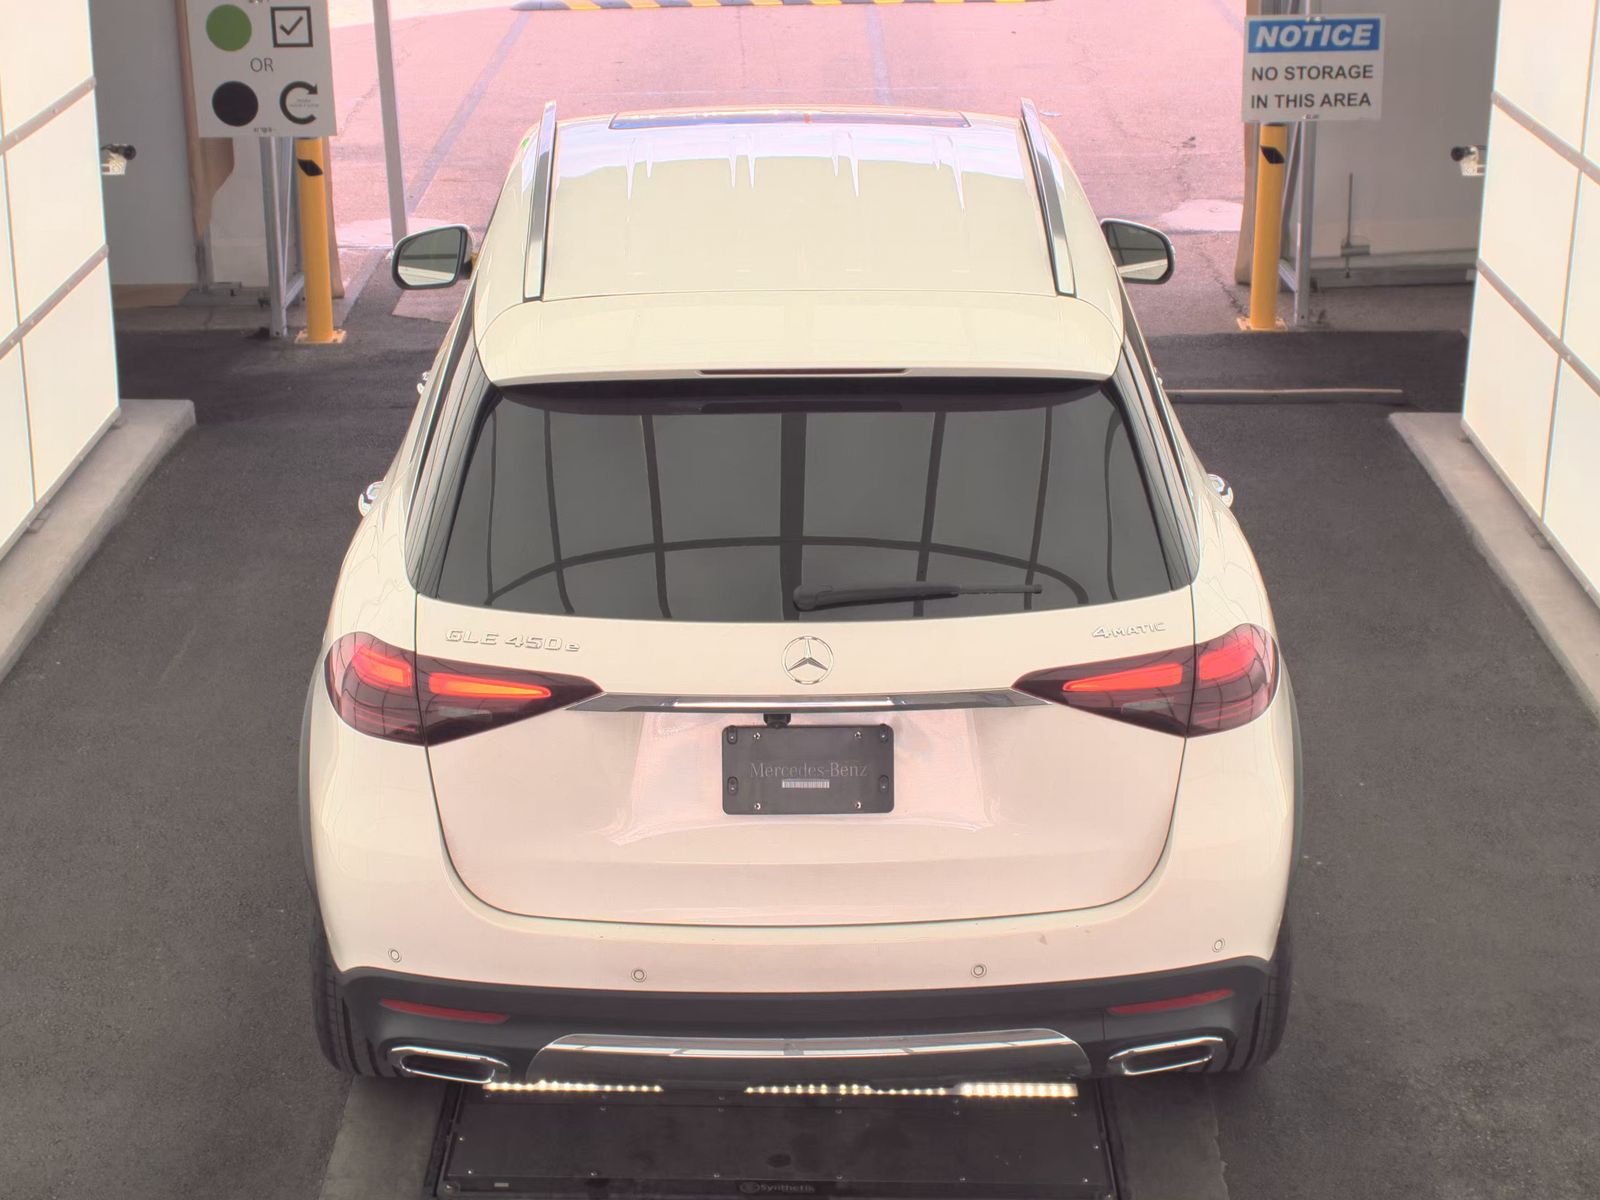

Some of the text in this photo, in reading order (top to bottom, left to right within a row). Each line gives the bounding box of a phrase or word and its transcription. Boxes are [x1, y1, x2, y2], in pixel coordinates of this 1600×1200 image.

[1255, 23, 1374, 48] NOTICE
[250, 57, 274, 72] OR
[1251, 64, 1374, 81] NO STORAGE
[1251, 93, 1371, 108] IN THIS AREA
[446, 628, 499, 645] GLE
[1092, 622, 1167, 638] 4MATIC
[750, 761, 867, 778] Mercedes-Benz
